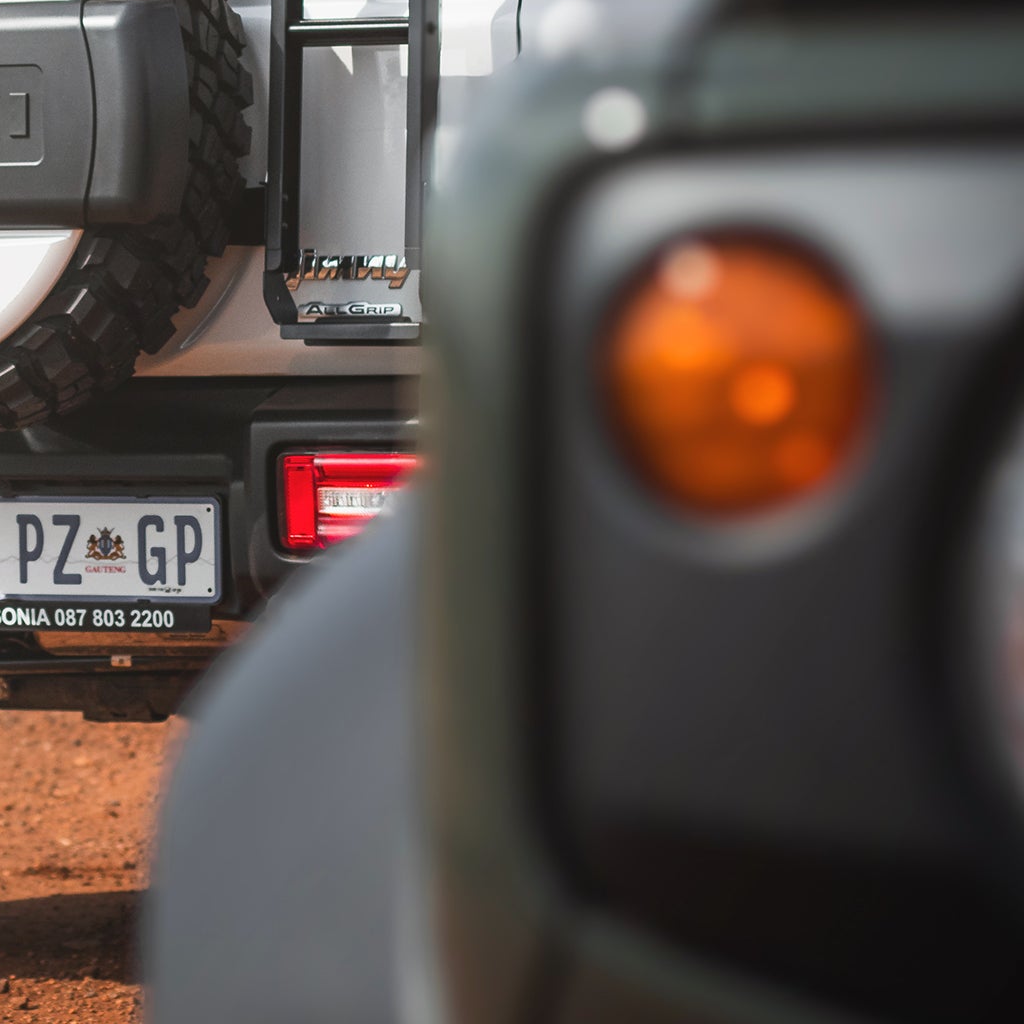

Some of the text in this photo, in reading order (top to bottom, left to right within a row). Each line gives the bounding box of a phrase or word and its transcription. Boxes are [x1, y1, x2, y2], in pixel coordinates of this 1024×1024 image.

[16, 514, 82, 585] PZ
[137, 515, 203, 586] GP
[85, 565, 126, 574] GAUTENG
[54, 608, 87, 626] 087
[92, 609, 125, 627] 803
[130, 609, 174, 628] 2200
